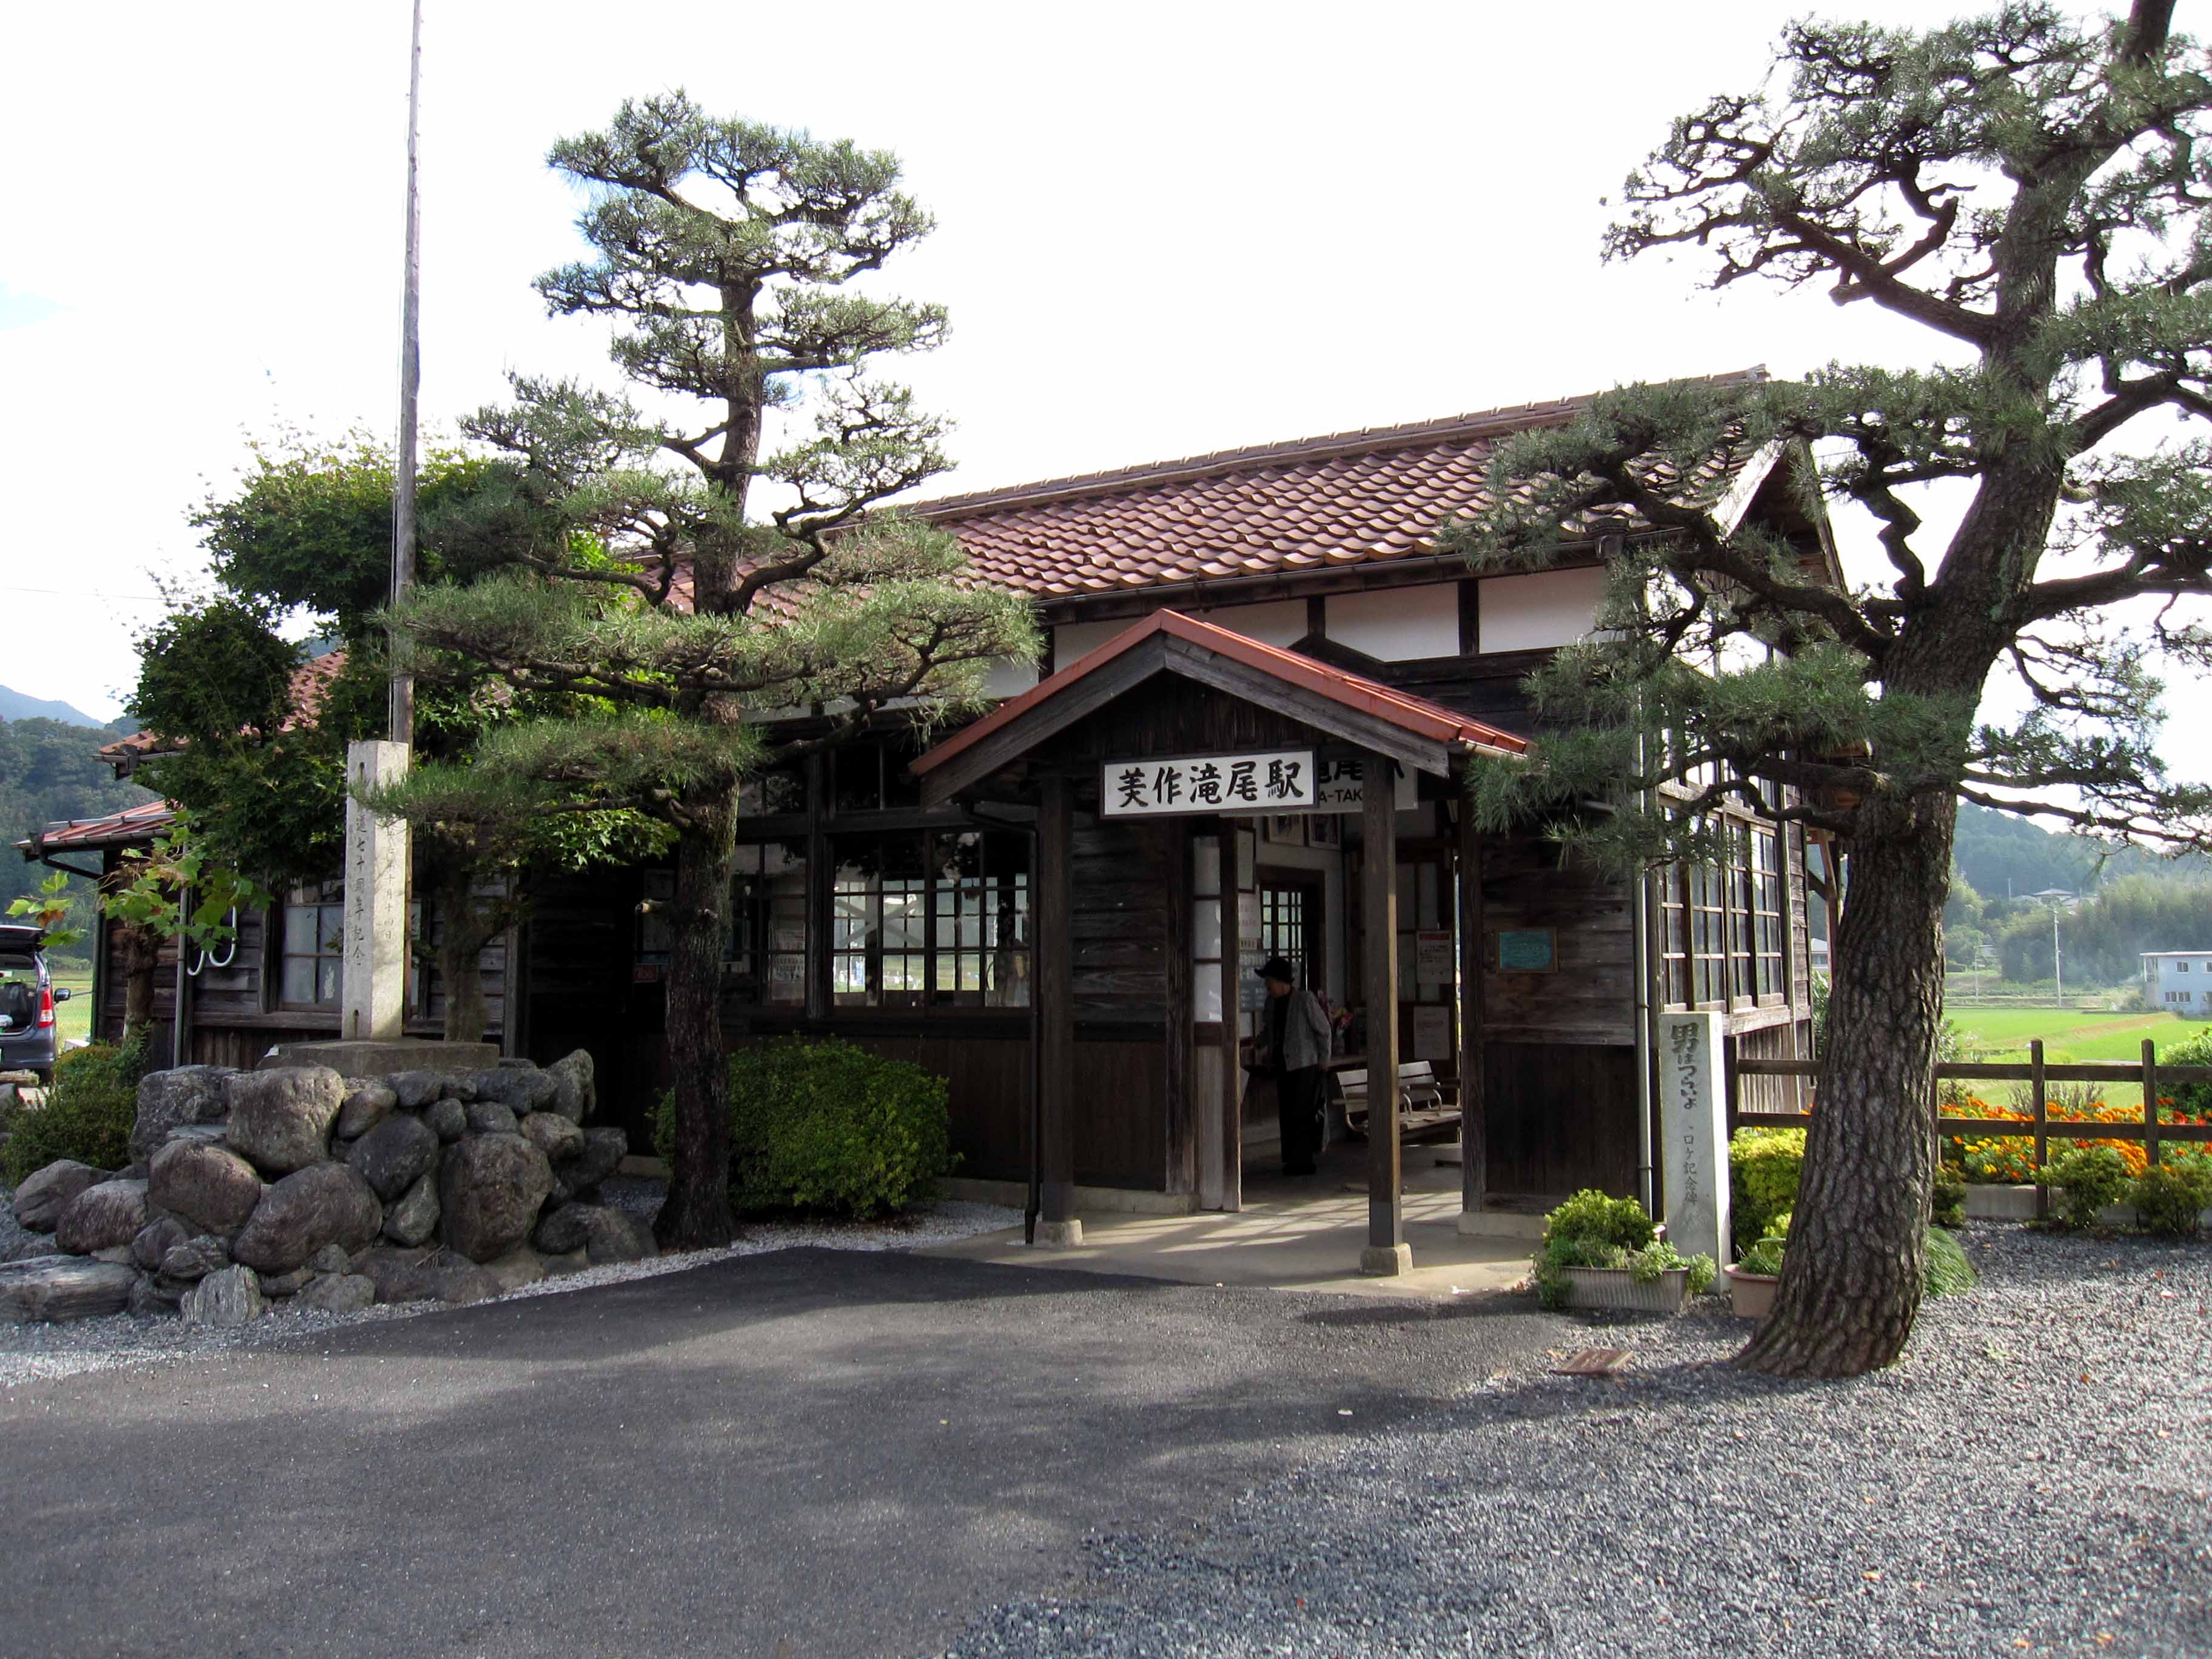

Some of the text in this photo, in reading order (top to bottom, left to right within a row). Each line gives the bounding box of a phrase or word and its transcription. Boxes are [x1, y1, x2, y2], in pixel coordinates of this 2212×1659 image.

[1117, 759, 1304, 808] 美作滝尾駅
[1671, 1022, 1699, 1109] 男はつらいよ
